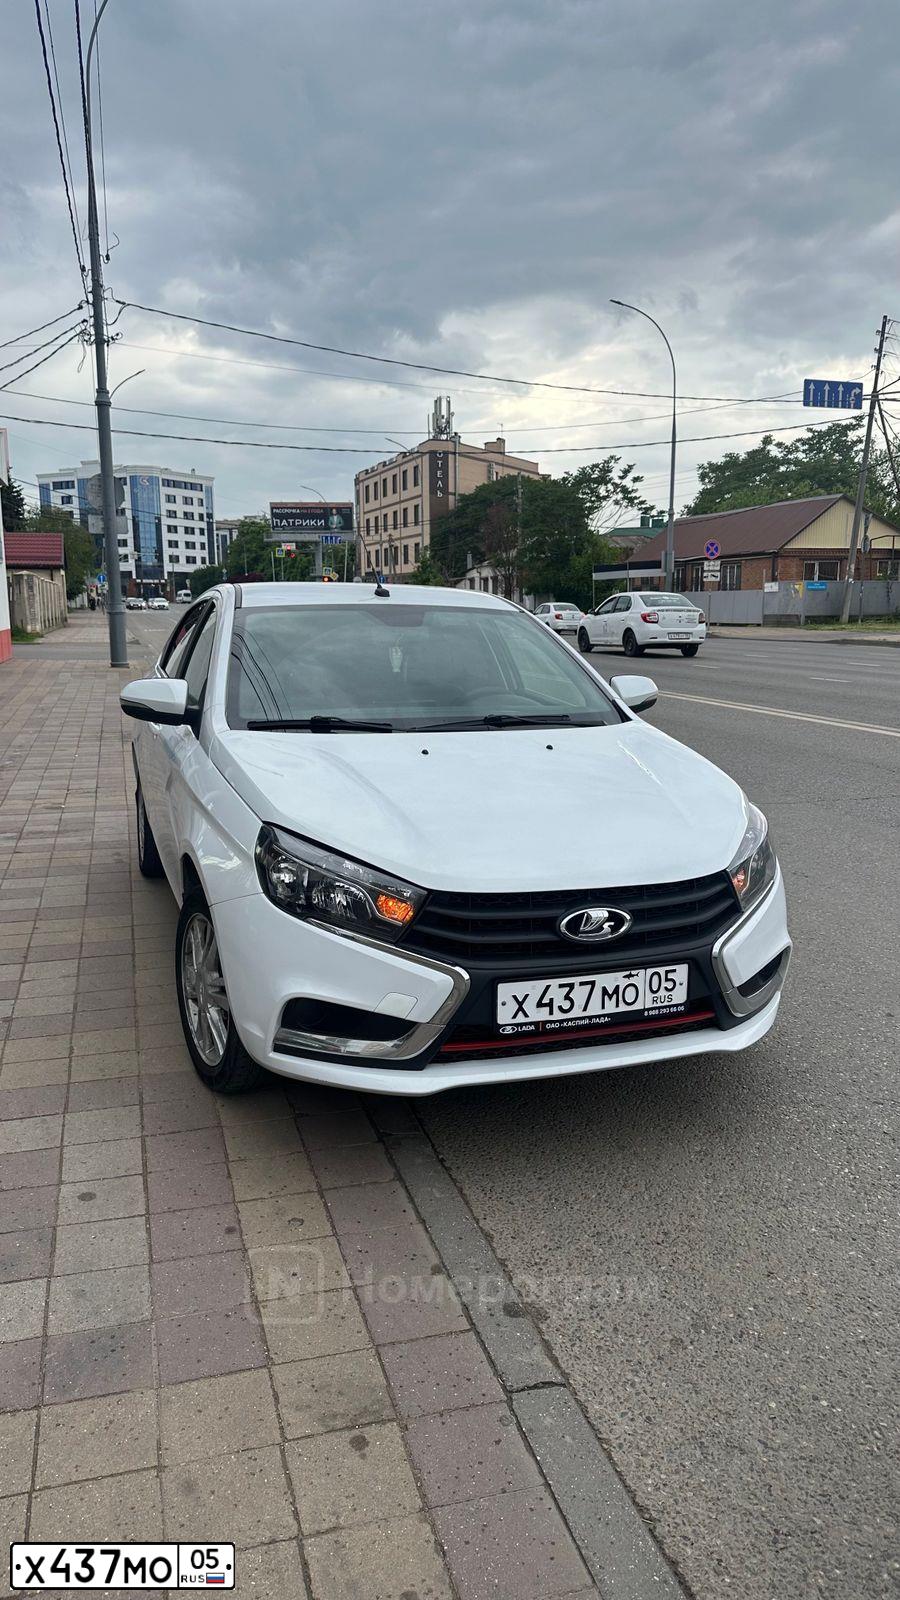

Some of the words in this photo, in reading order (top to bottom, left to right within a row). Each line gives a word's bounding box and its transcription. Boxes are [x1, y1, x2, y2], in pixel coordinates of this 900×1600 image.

[273, 518, 325, 526] ПАТРИКИ
[649, 969, 677, 994] 05
[652, 994, 673, 1005] RUS
